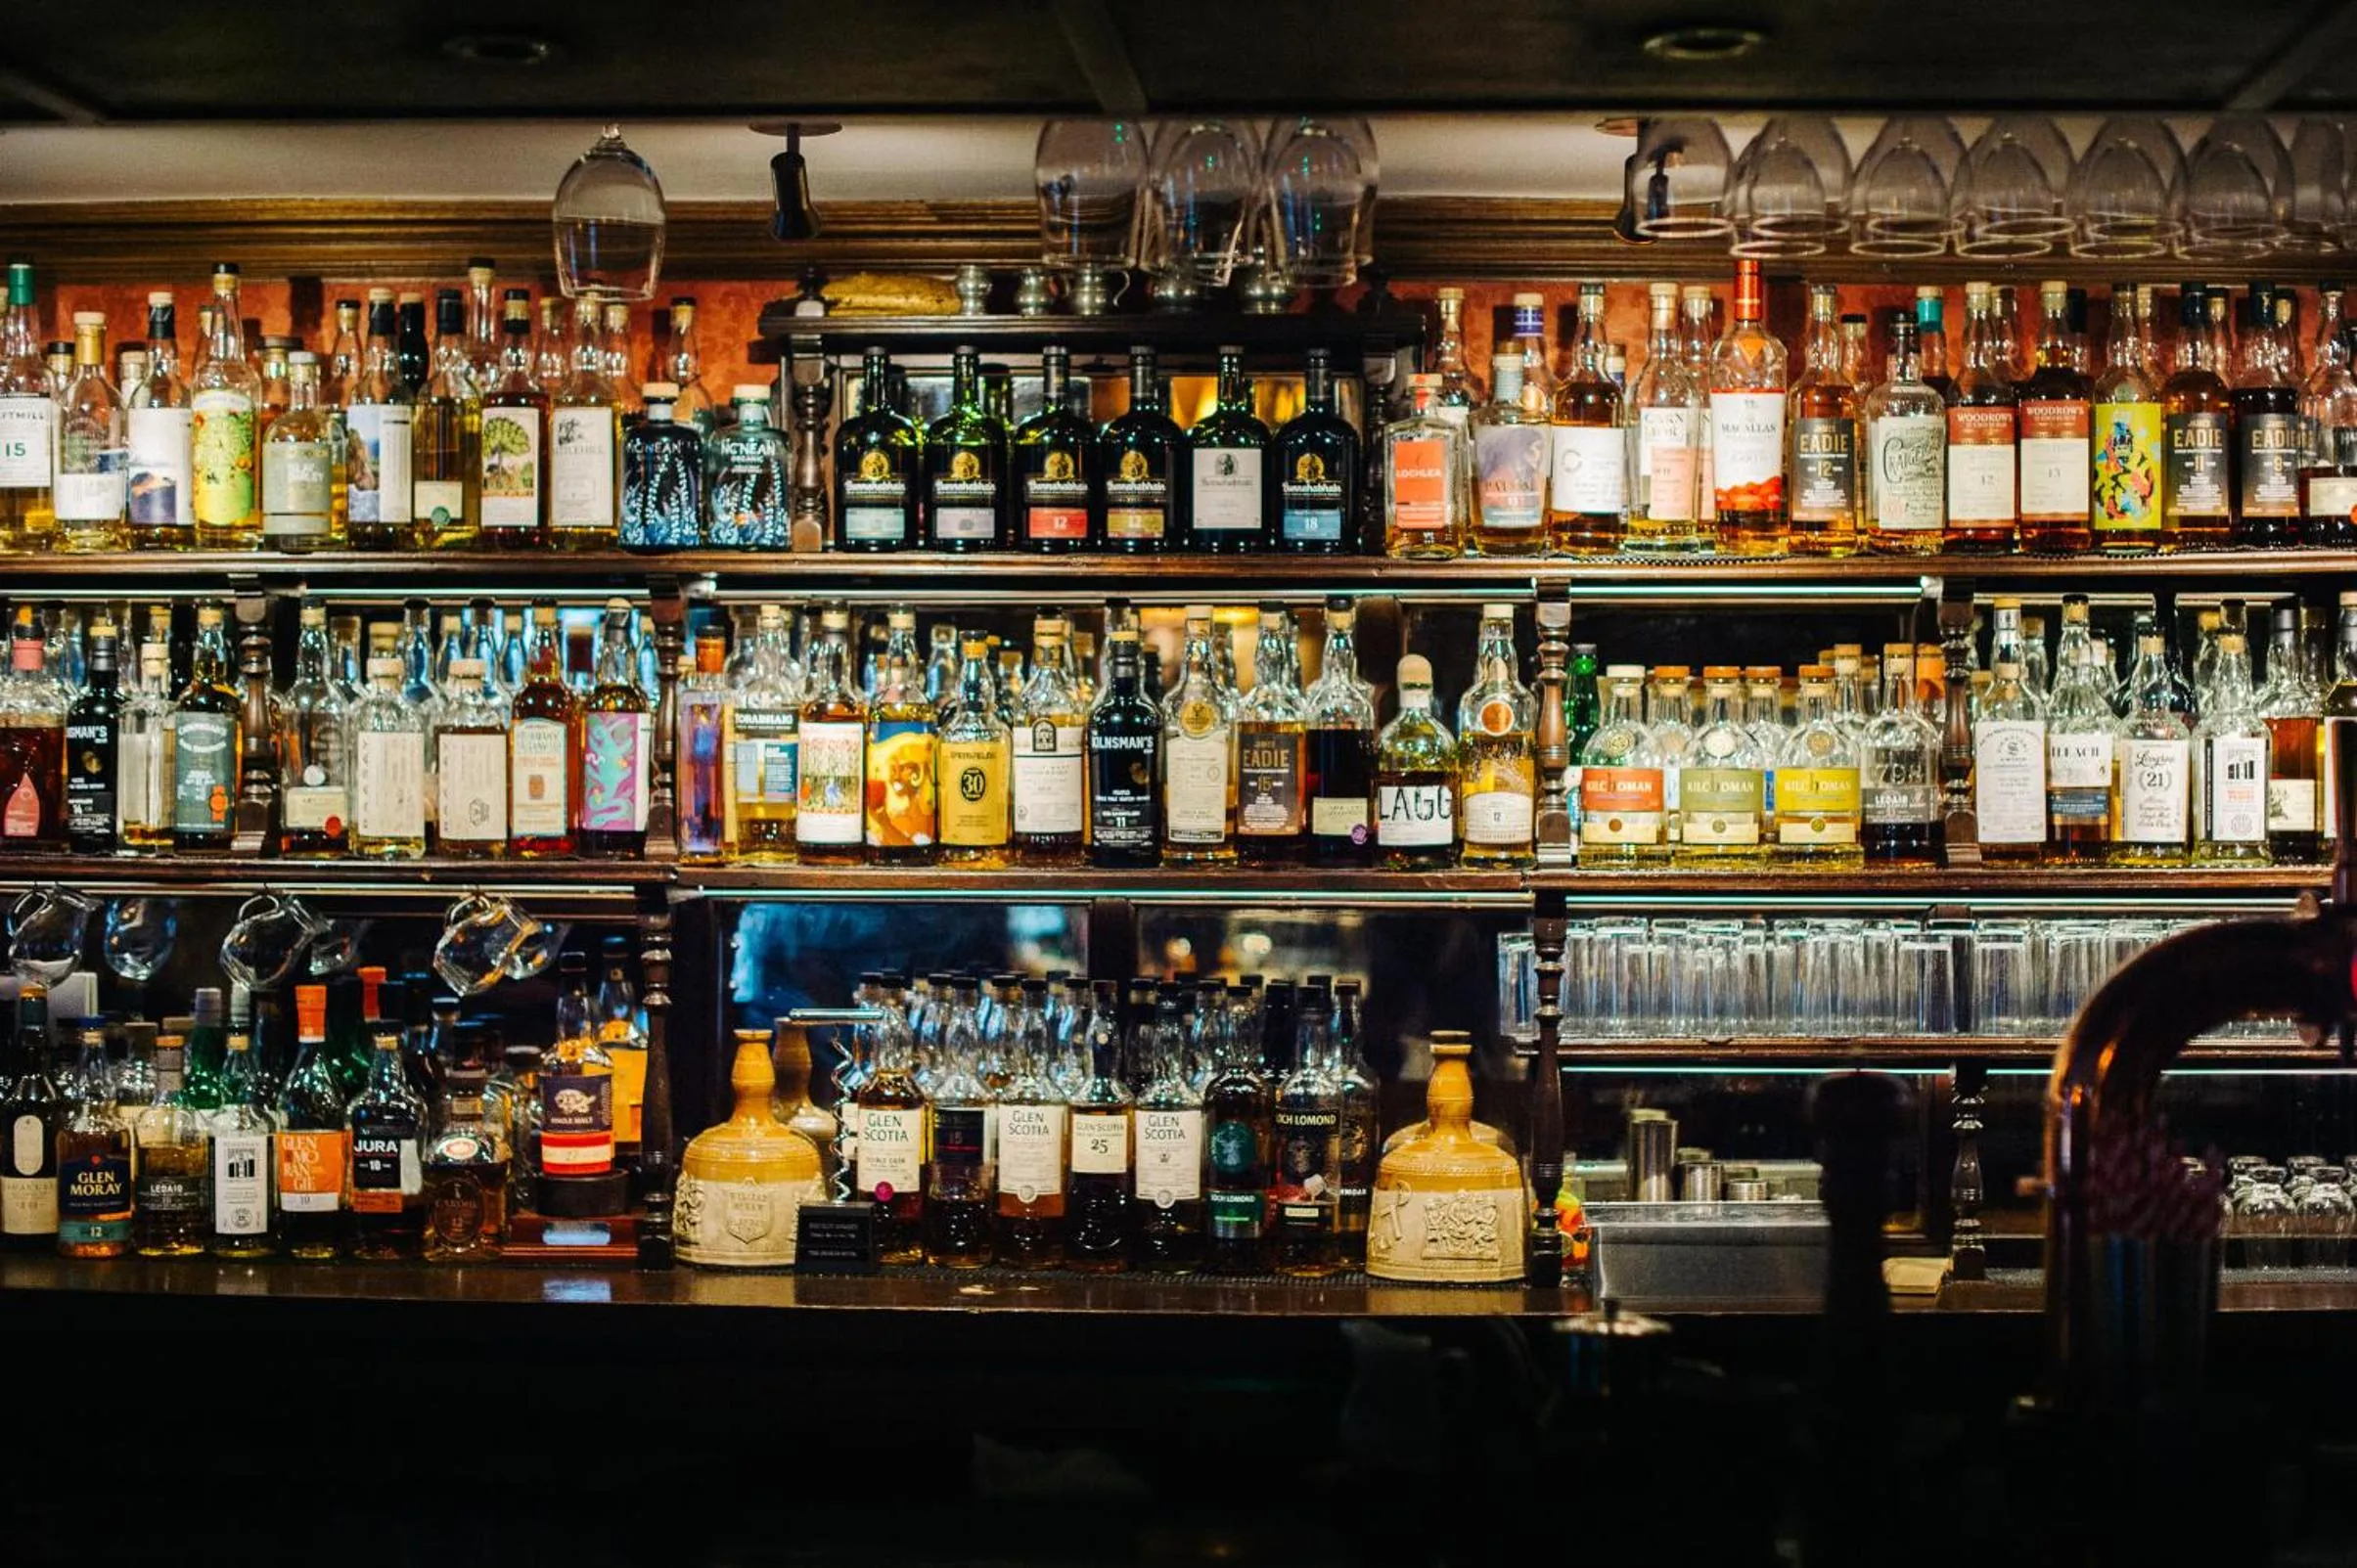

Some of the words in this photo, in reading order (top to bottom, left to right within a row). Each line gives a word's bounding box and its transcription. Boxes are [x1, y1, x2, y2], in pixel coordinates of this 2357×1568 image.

[1799, 434, 1848, 452] EADIE
[2174, 429, 2223, 448] EADIE
[6, 442, 26, 457] 15
[1818, 461, 1833, 477] 12
[1304, 516, 1319, 531] 18
[1091, 736, 1155, 749] KILNSMAN'S
[1244, 750, 1290, 767] EADIE
[963, 774, 984, 794] 30
[2147, 772, 2165, 788] 21
[868, 1113, 901, 1127] GLEN
[1013, 1110, 1044, 1123] GLEN
[1148, 1115, 1180, 1127] GLEN
[1294, 1114, 1337, 1125] LOMOND
[864, 1127, 909, 1142] SCOTIA
[1009, 1124, 1050, 1136] SCOTIA
[1145, 1128, 1186, 1141] SCOTIA
[354, 1139, 398, 1152] JURA
[1091, 1139, 1109, 1154] 25
[77, 1171, 115, 1184] GLEN
[69, 1183, 122, 1196] MORAY
